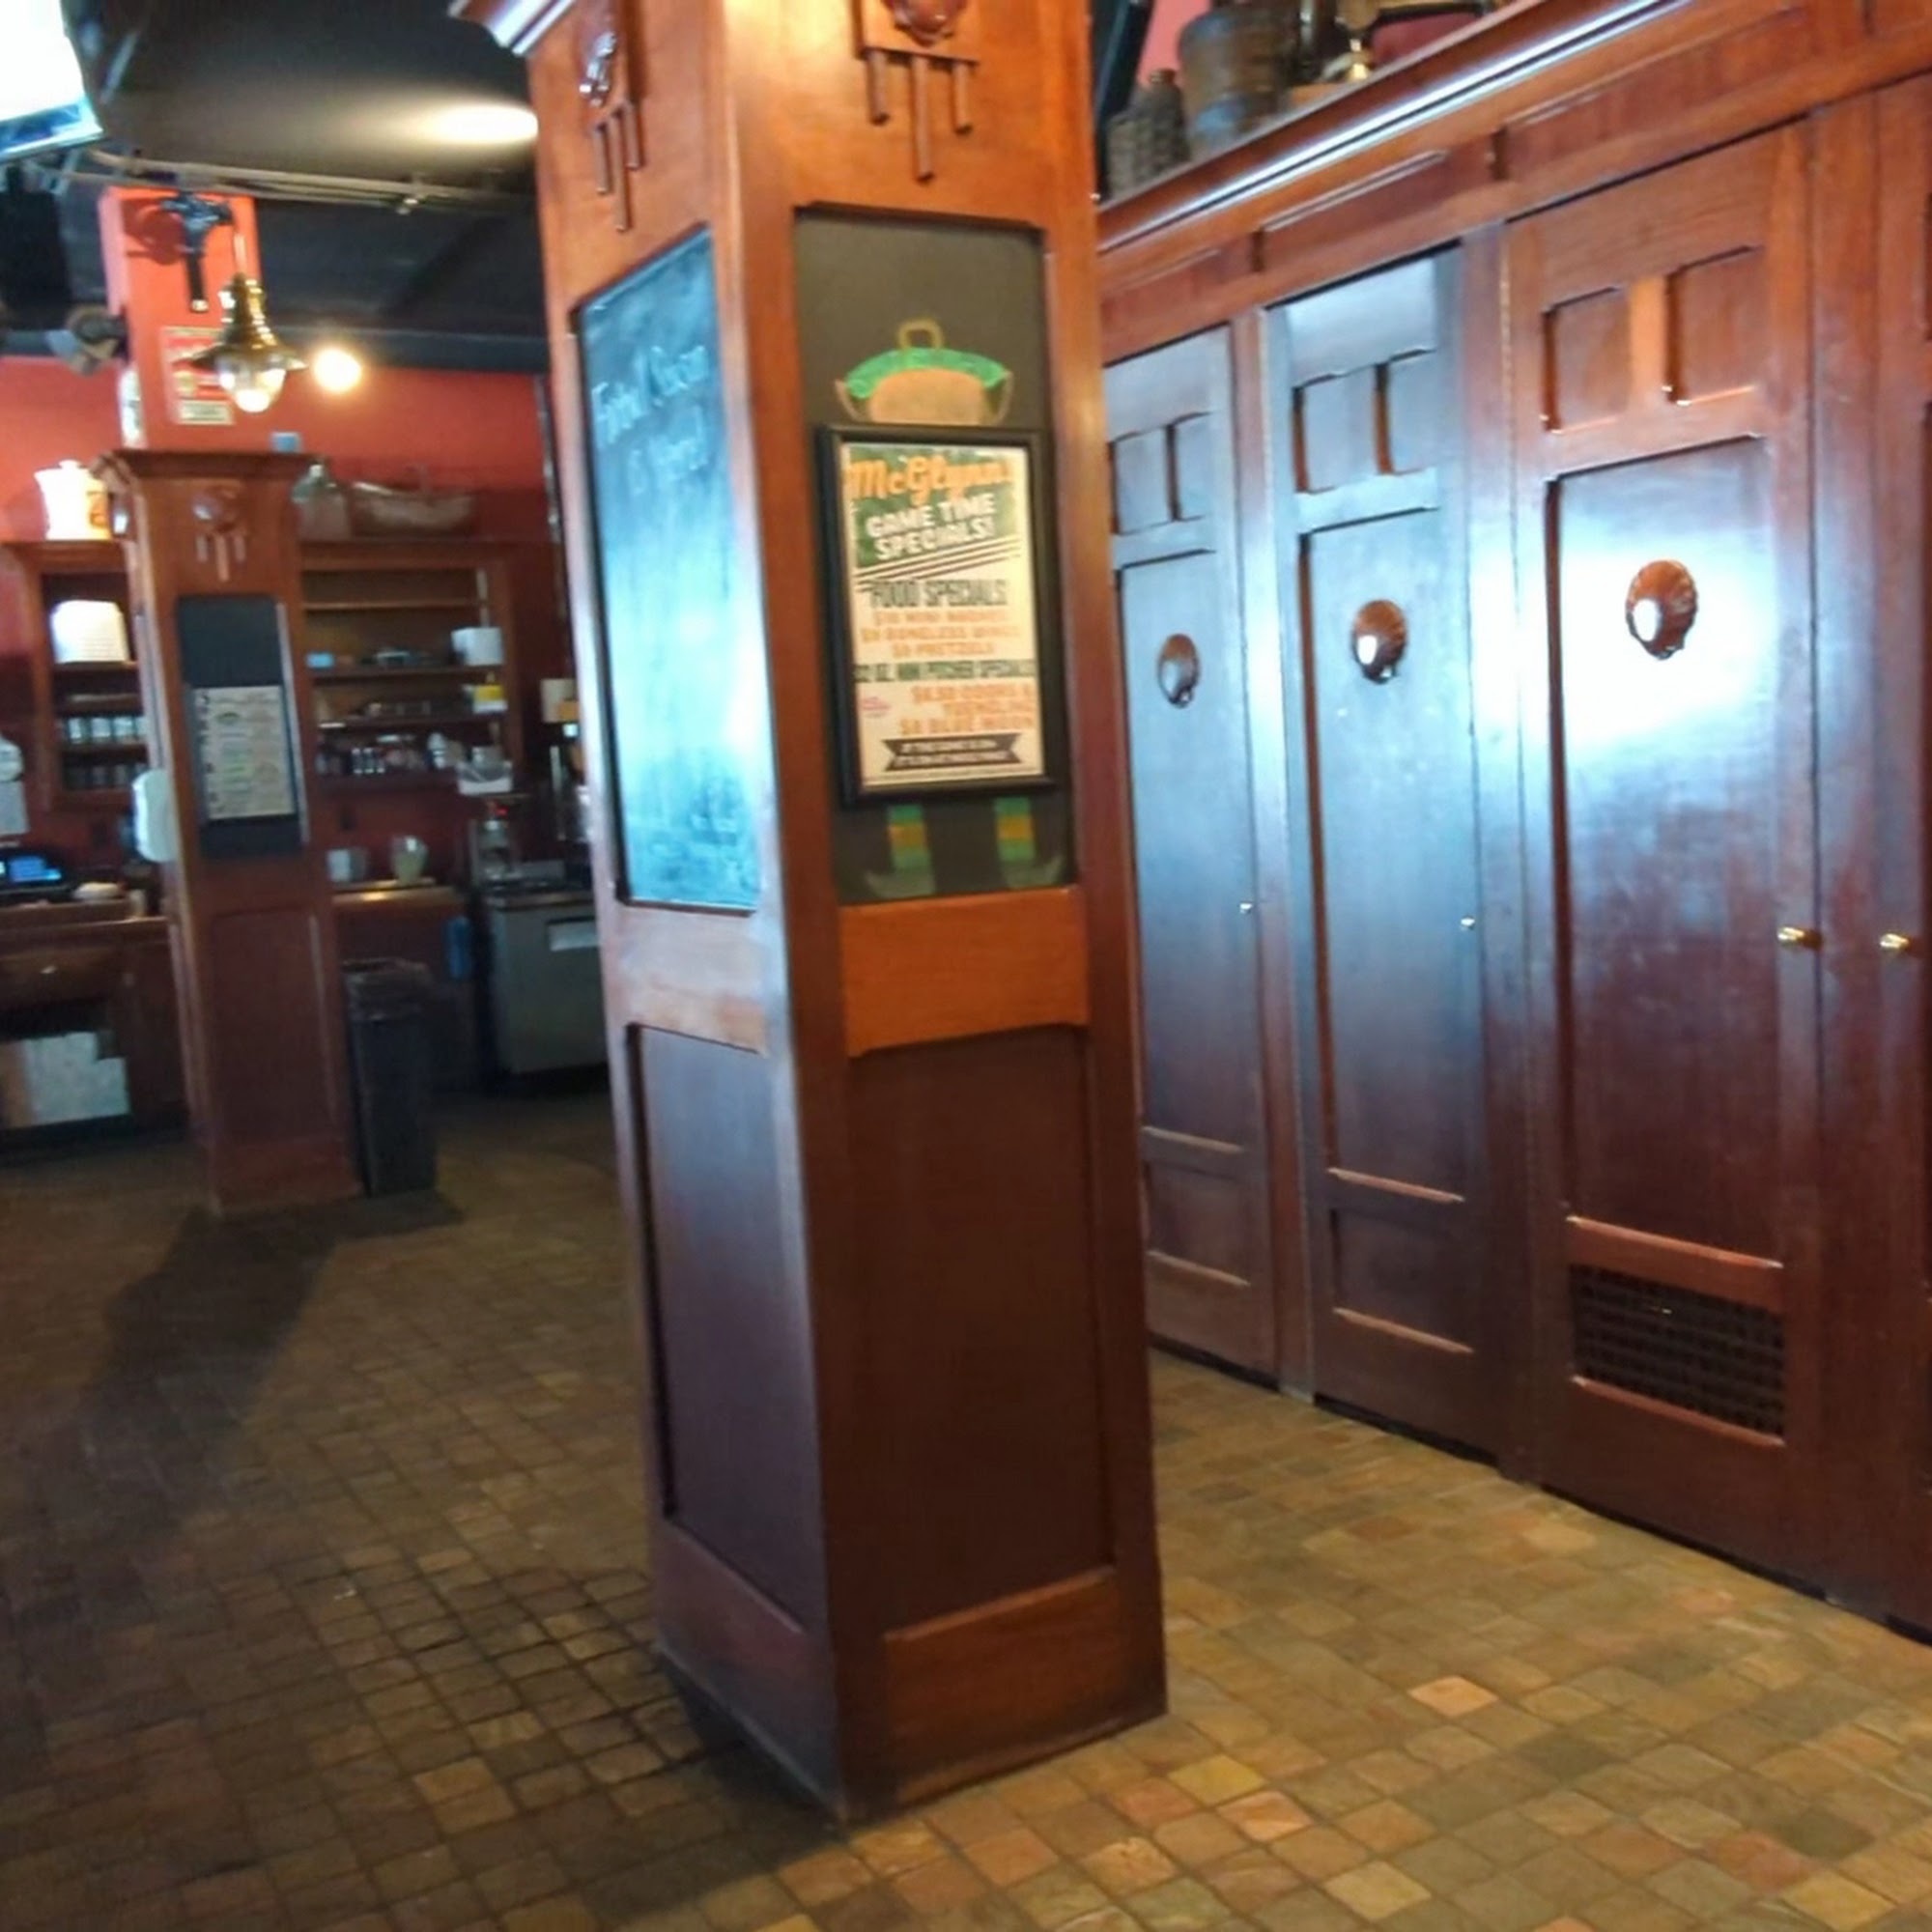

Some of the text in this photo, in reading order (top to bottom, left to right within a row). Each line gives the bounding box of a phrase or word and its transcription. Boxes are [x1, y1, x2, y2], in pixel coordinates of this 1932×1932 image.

[867, 494, 995, 537] GAME TIME
[872, 580, 918, 608] FOOD
